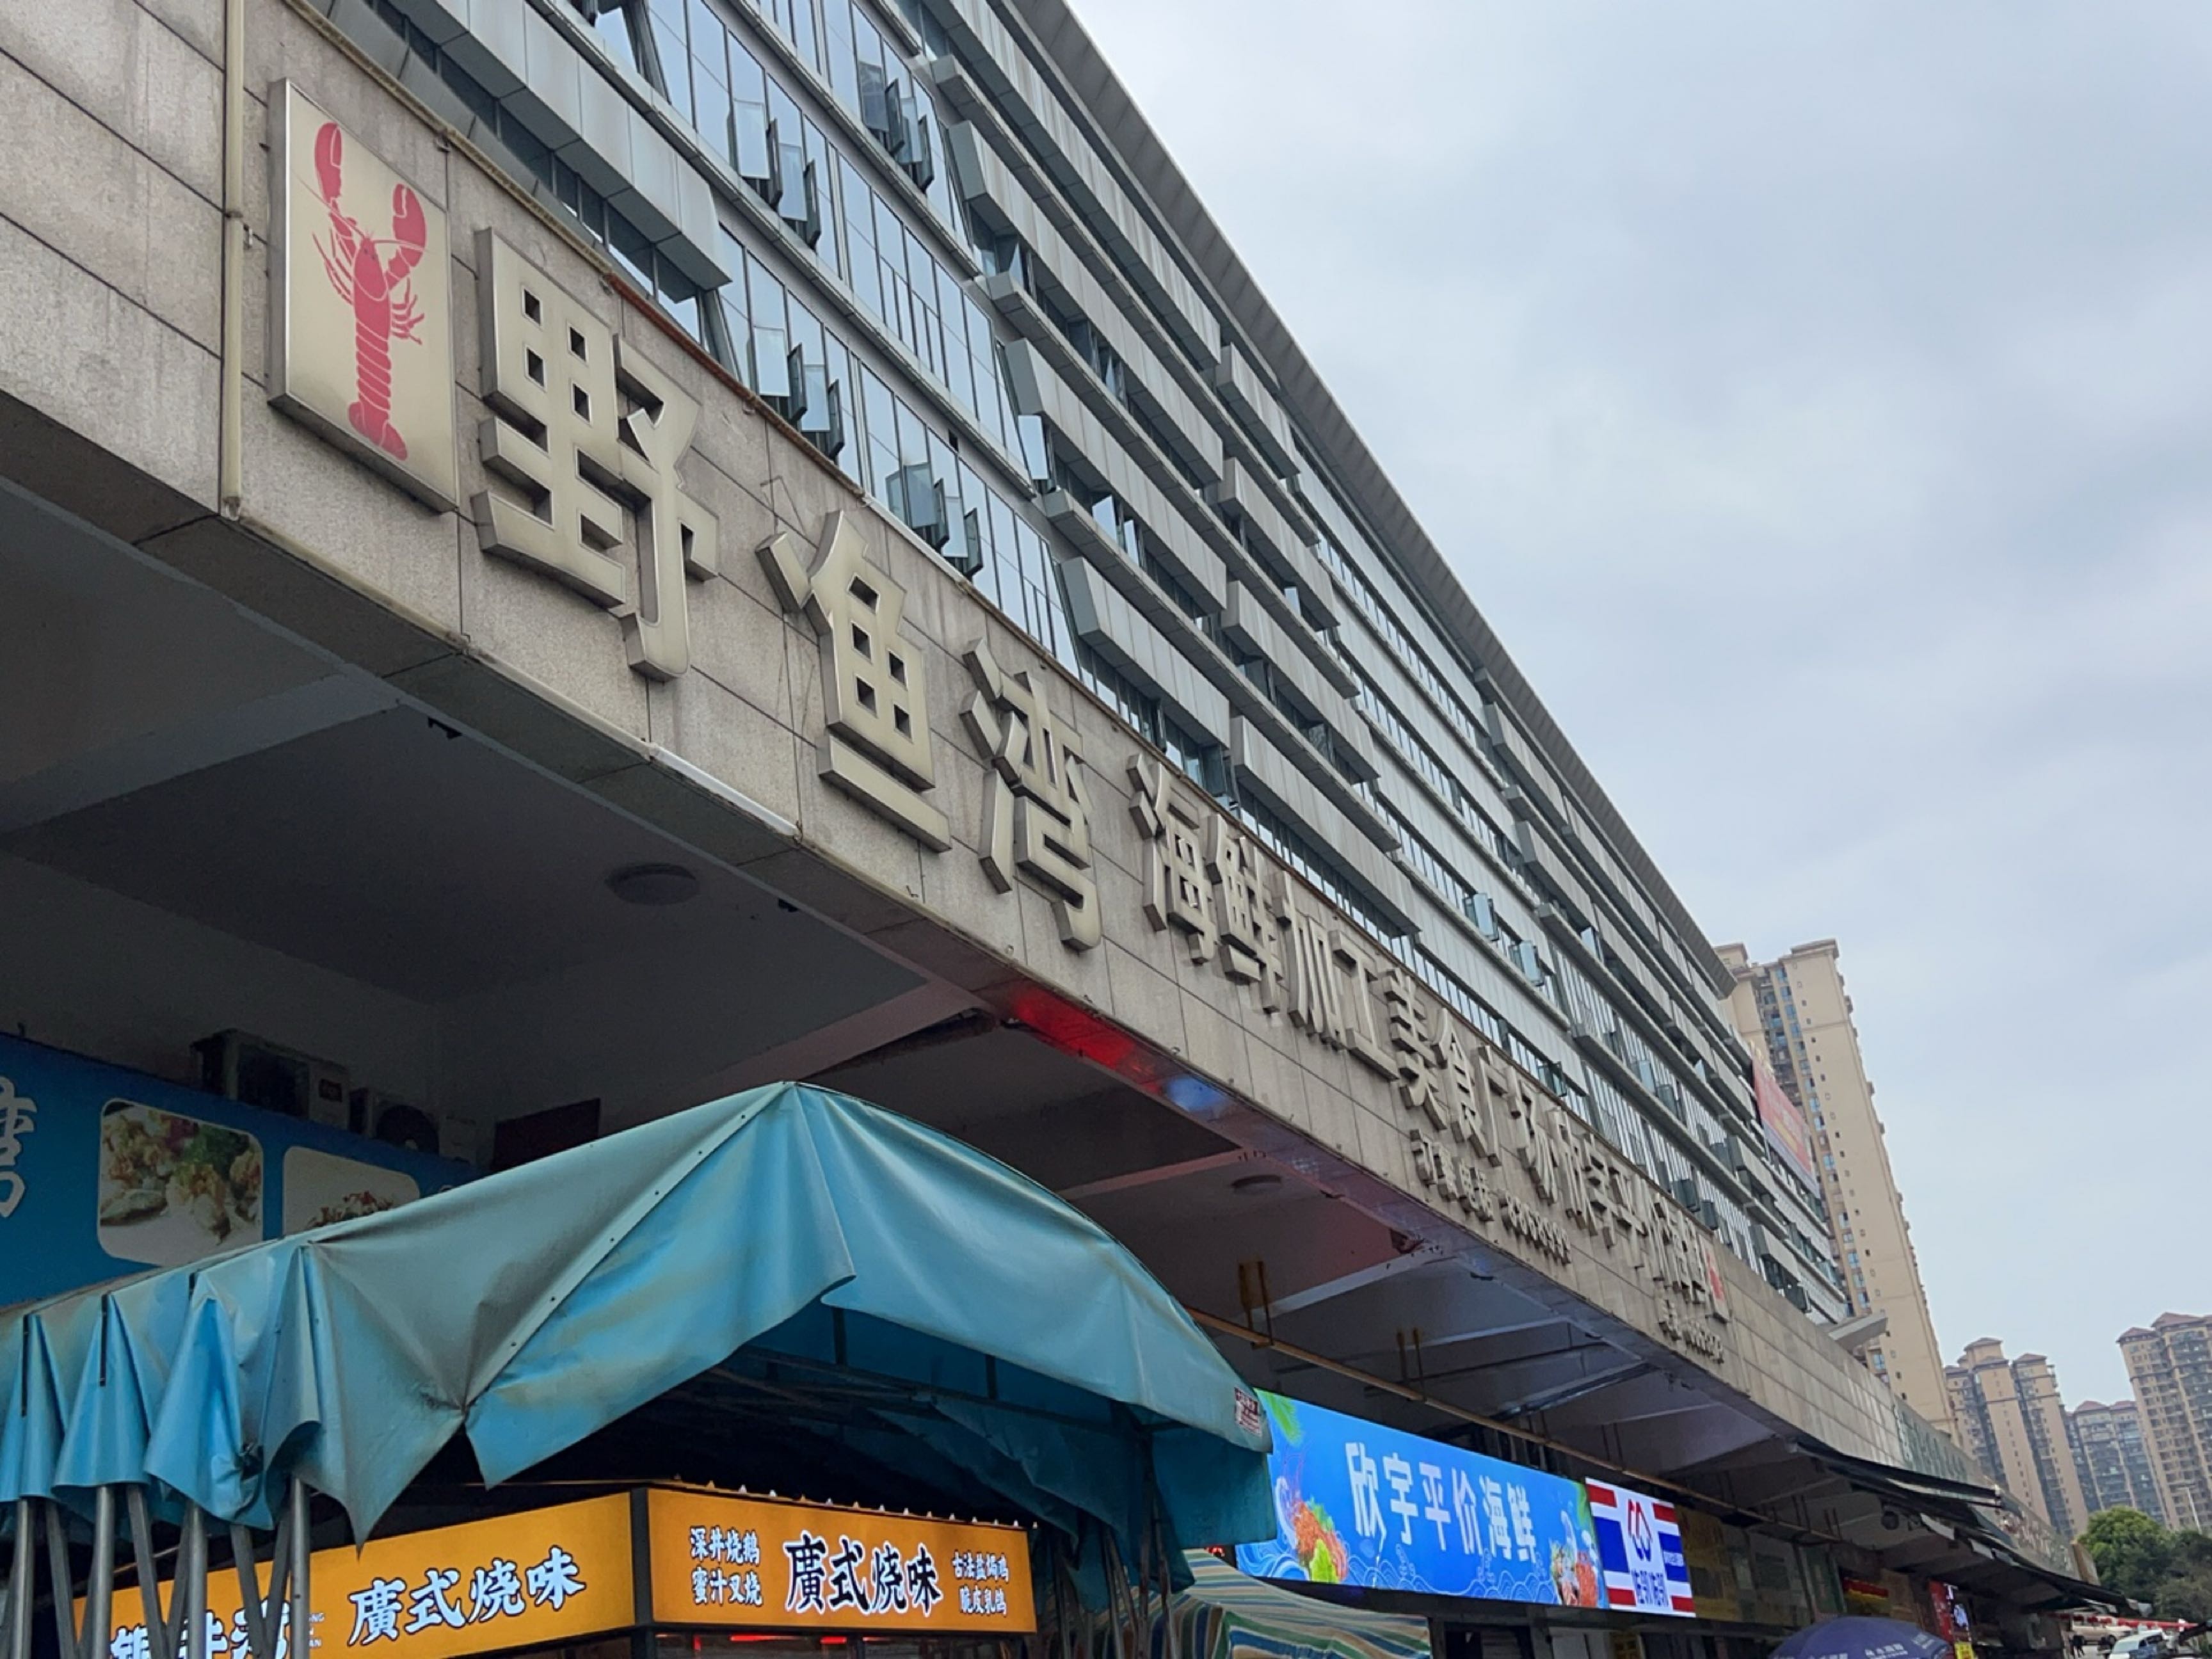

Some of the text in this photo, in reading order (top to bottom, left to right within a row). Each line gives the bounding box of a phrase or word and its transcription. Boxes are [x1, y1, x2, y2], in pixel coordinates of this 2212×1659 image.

[477, 227, 1102, 950] 野鱼湾
[1345, 1443, 1535, 1563] 欣宇平价海鲜
[691, 1527, 760, 1566] 深井烧鹅
[693, 1566, 762, 1606] 蜜汁叉烧
[782, 1530, 942, 1616] 廣式烧味
[348, 1544, 586, 1646] 廣式烧味
[959, 1584, 1007, 1616] 脆皮乳鸽
